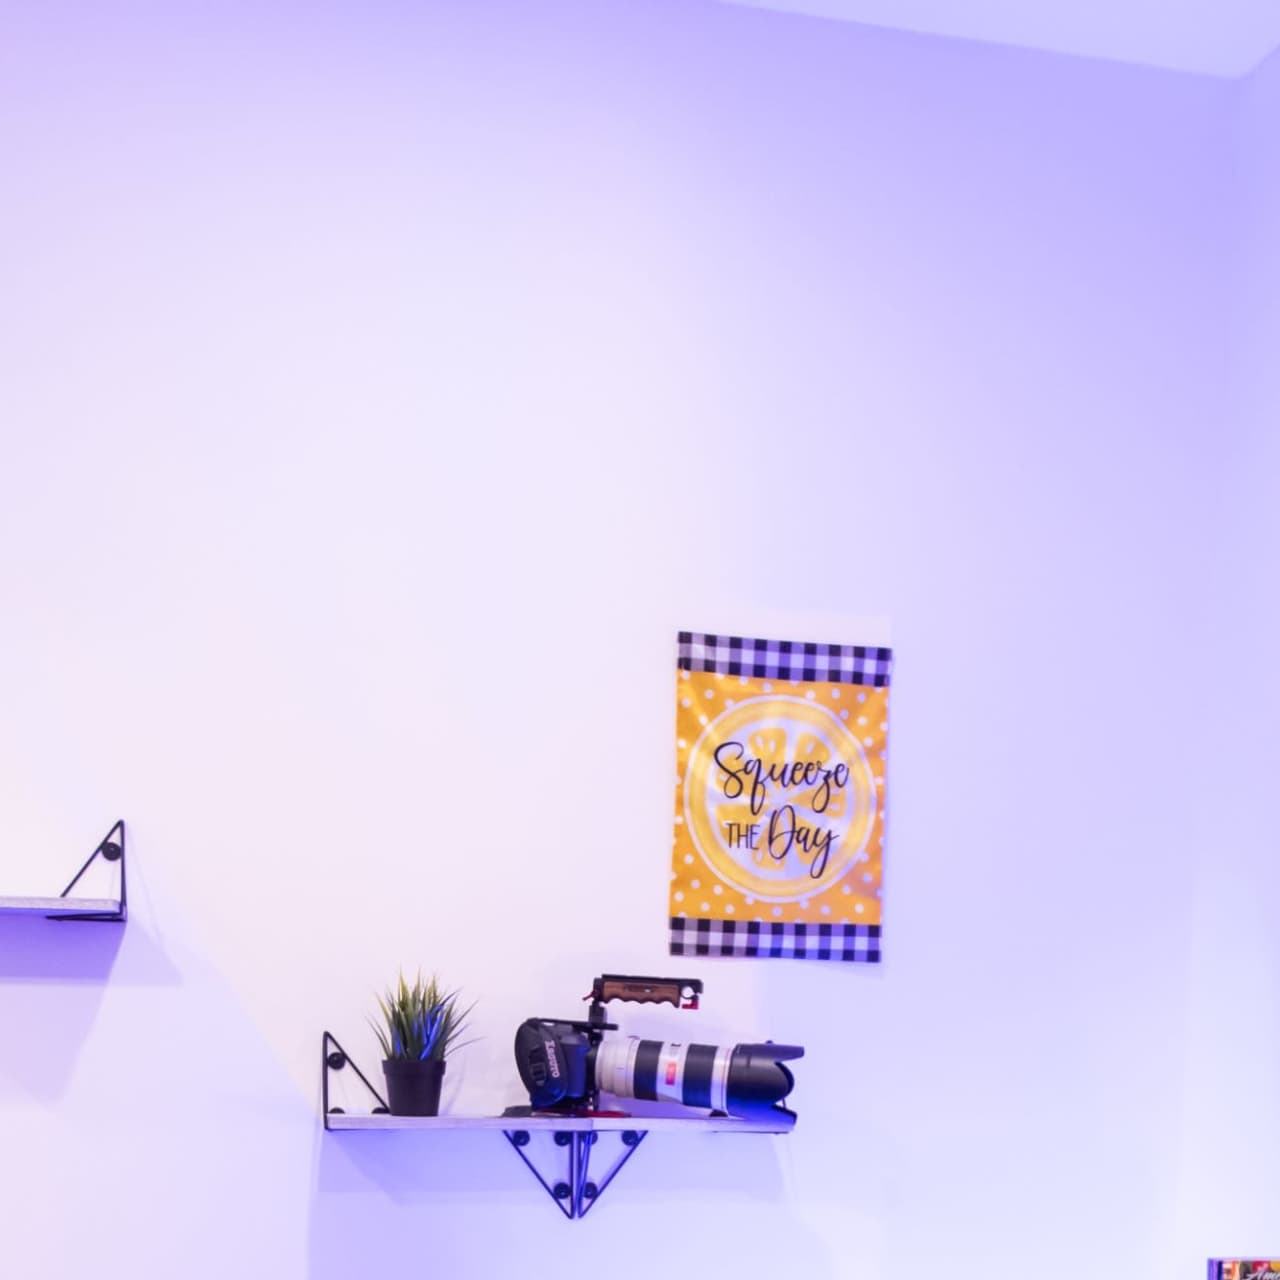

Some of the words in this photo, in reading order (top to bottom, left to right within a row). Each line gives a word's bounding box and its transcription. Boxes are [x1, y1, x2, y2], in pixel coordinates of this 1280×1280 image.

[713, 741, 850, 815] Squeeze
[725, 822, 761, 850] THE
[768, 804, 839, 879] Day
